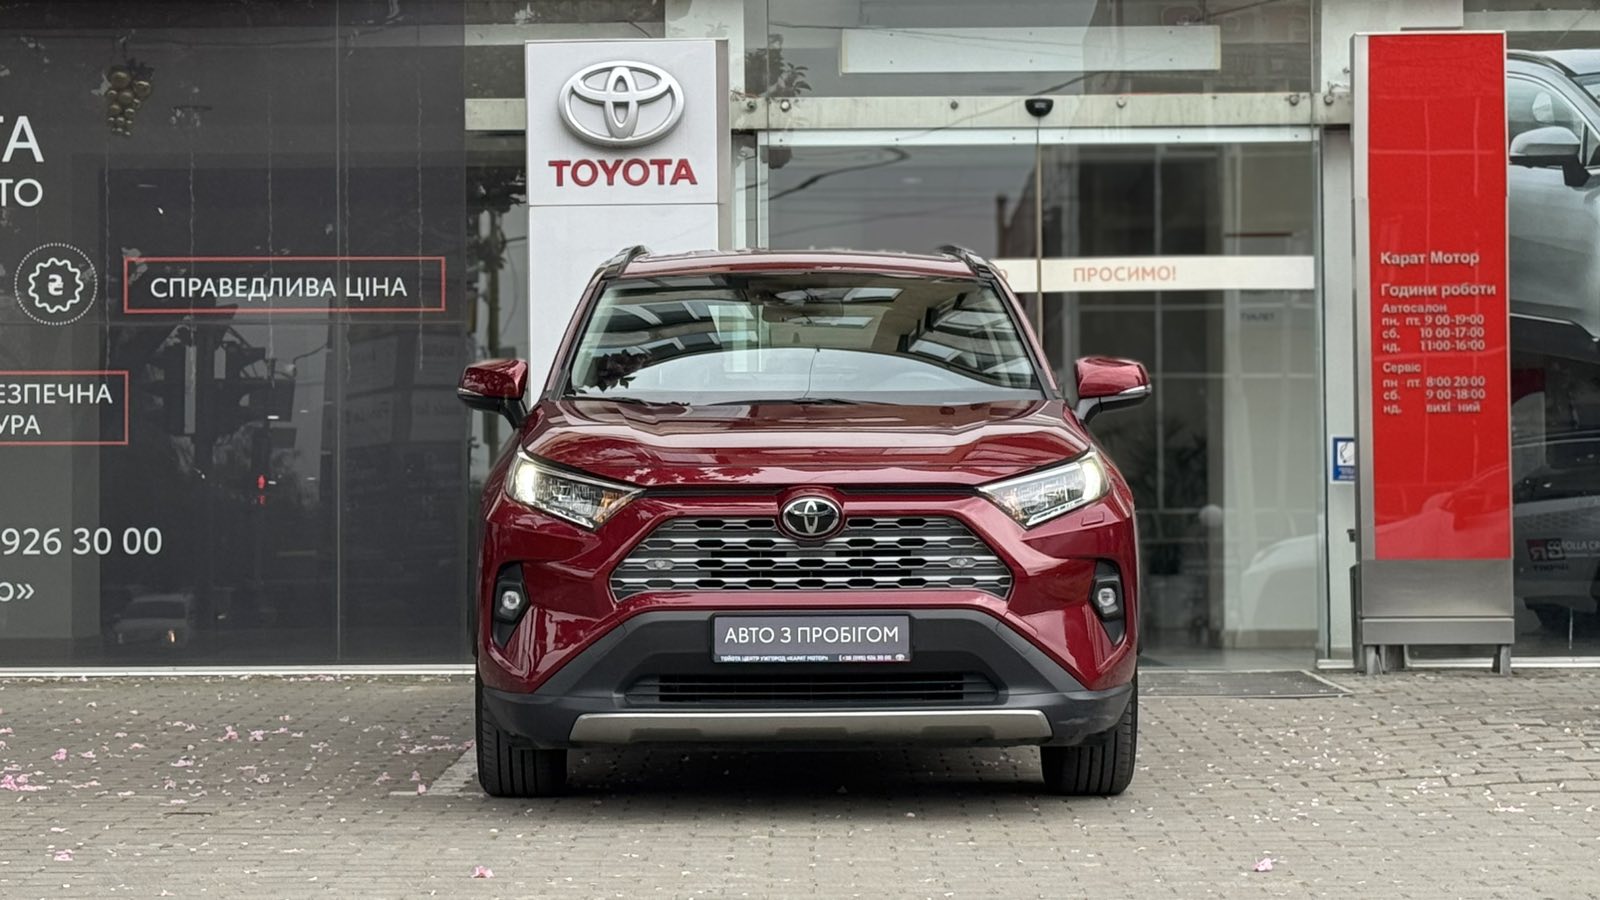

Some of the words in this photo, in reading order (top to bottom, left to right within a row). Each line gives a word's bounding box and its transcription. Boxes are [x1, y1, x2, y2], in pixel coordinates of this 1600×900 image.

[548, 158, 698, 187] TOYOTA
[1380, 251, 1426, 268] Карат
[1430, 250, 1480, 267] Мотор
[1073, 266, 1177, 283] ПРОСИМО!
[150, 277, 337, 301] СПРАВЕДЛИВА
[345, 277, 407, 301] ЦІНА
[1380, 283, 1438, 298] Години
[1441, 282, 1497, 299] роботи
[1382, 303, 1447, 314] Автосалон
[1382, 328, 1401, 339] сб.
[1383, 343, 1401, 353] нд.
[1382, 362, 1422, 374] Сервіс
[1, 527, 62, 555] 926
[73, 527, 112, 555] 30
[123, 527, 162, 555] 00
[724, 627, 775, 644] АВТО
[780, 627, 792, 643] З
[797, 626, 899, 643] ПРОБІГОМ
